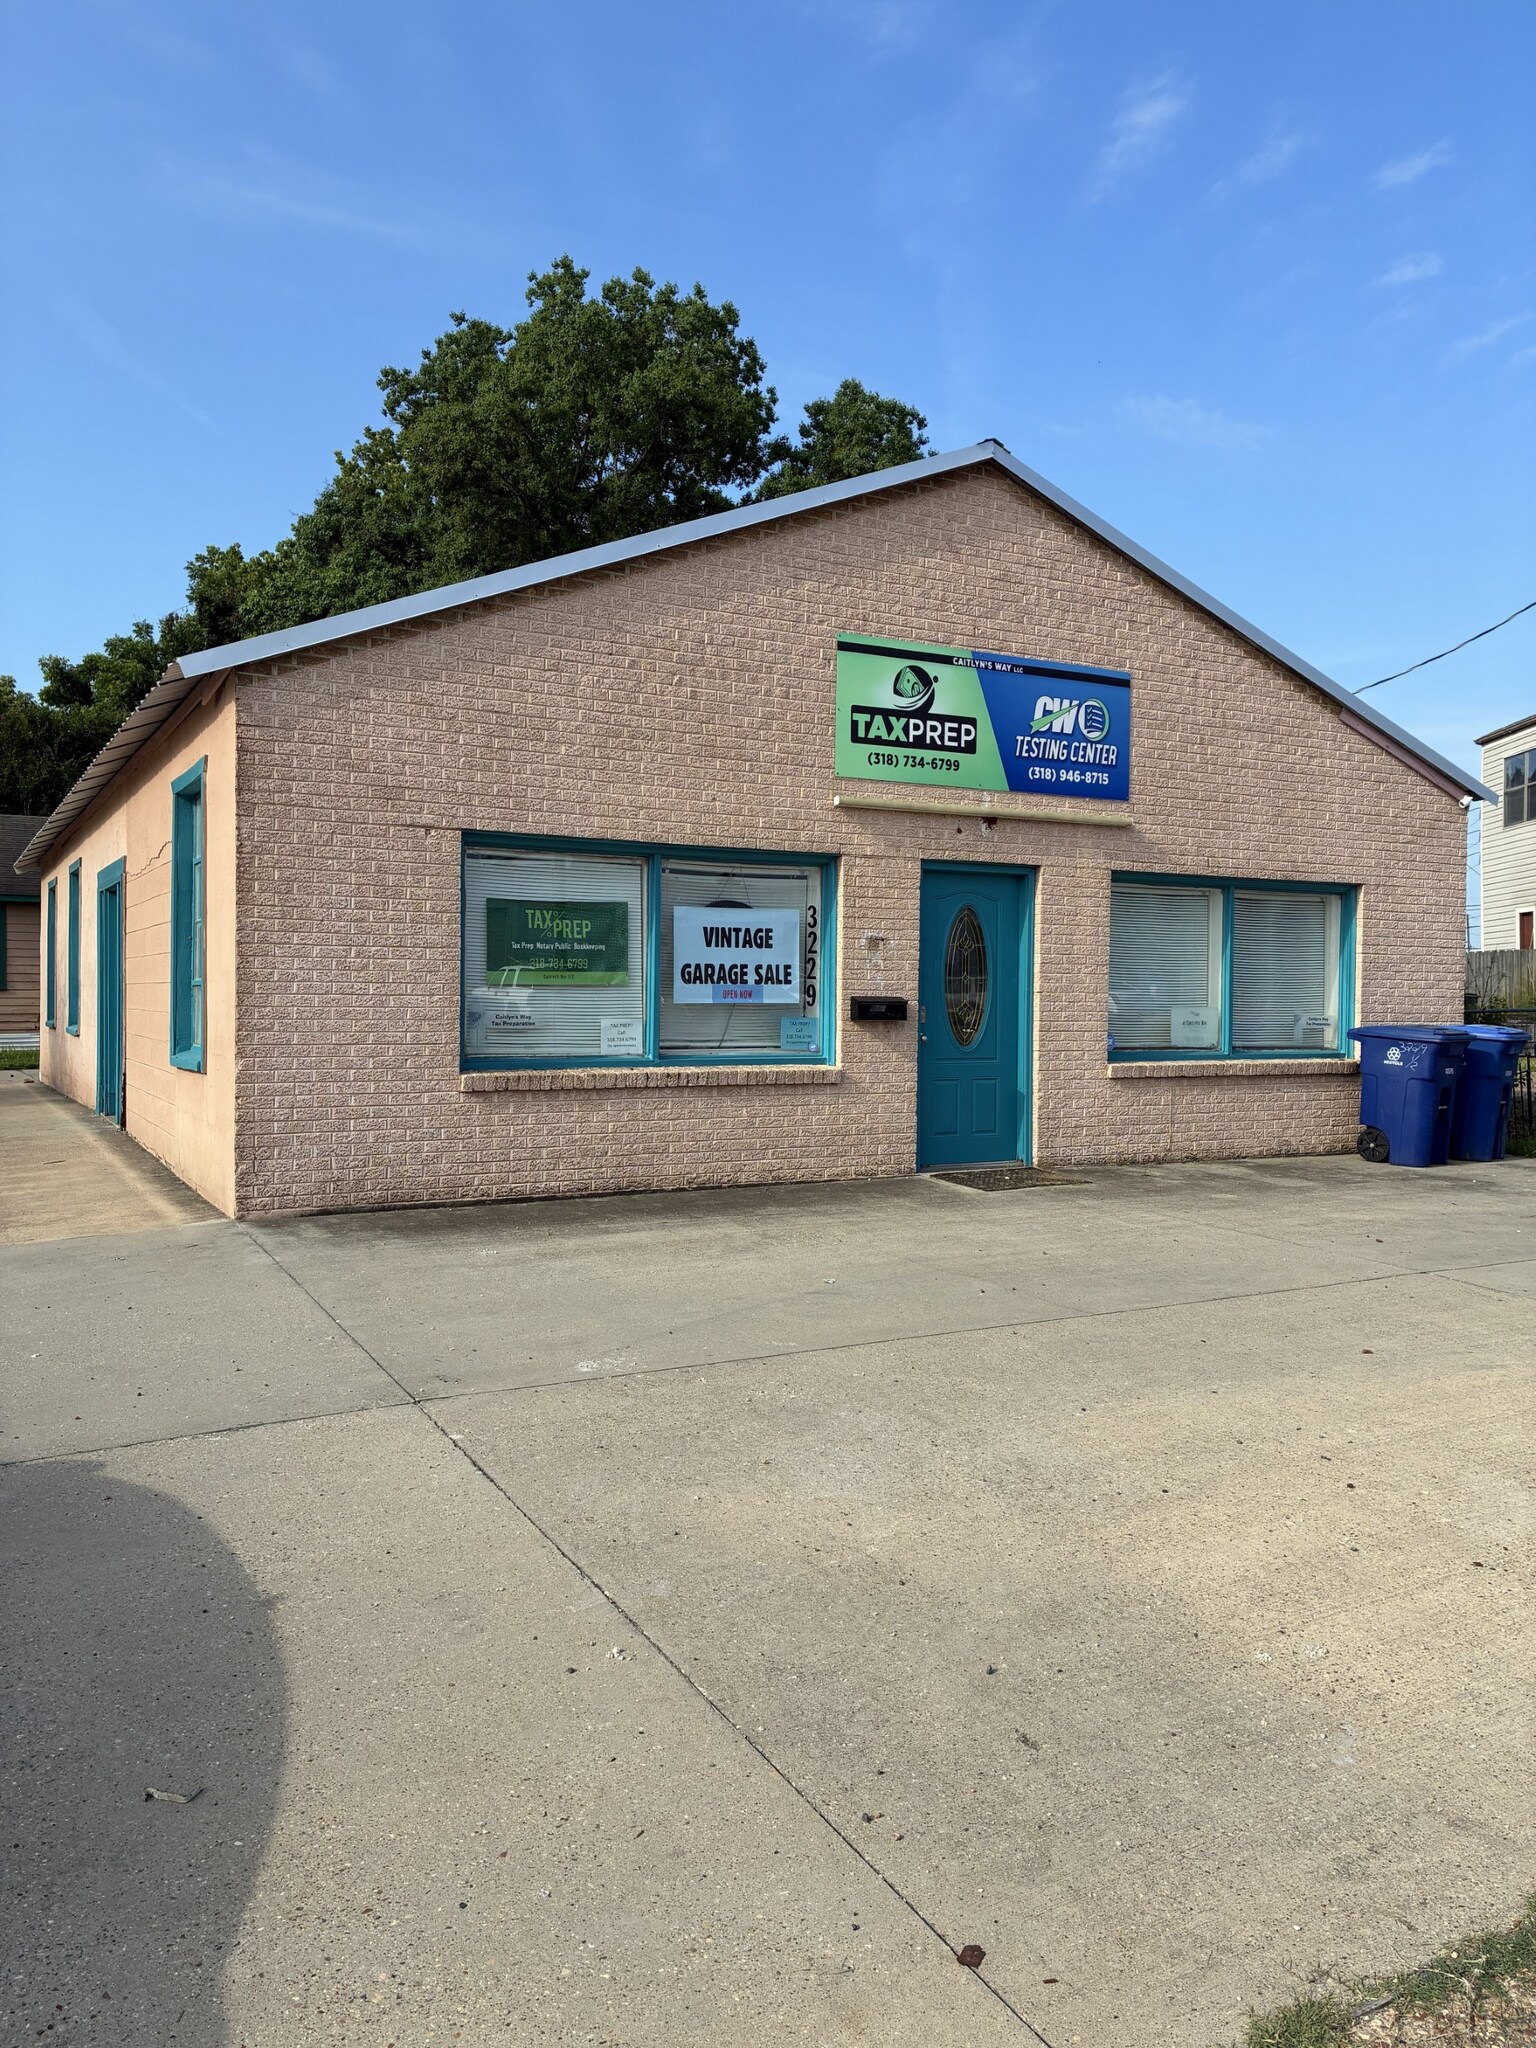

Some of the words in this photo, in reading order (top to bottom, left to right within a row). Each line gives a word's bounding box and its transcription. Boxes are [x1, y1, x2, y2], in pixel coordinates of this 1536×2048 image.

[952, 656, 993, 670] CAITLYN'S
[994, 663, 1012, 673] WAY
[1013, 666, 1024, 674] LLC
[1015, 735, 1068, 761] TESTING
[1070, 741, 1118, 766] CENTER
[867, 752, 899, 768] (318)
[903, 755, 960, 772] 734-6799
[1028, 766, 1057, 782] (318)
[1059, 769, 1109, 785] 946-8715
[525, 909, 553, 929] TAX
[553, 920, 591, 939] PREP
[702, 926, 774, 949] VINTAGE
[511, 941, 521, 949] Tax
[521, 941, 534, 950] Prep
[536, 942, 554, 951] Notary
[554, 942, 571, 950] Public
[573, 942, 606, 951] Bookkeeping
[680, 963, 749, 985] GARAGE
[753, 964, 792, 985] SALE
[722, 989, 738, 999] OPEN
[739, 989, 753, 999] NOW
